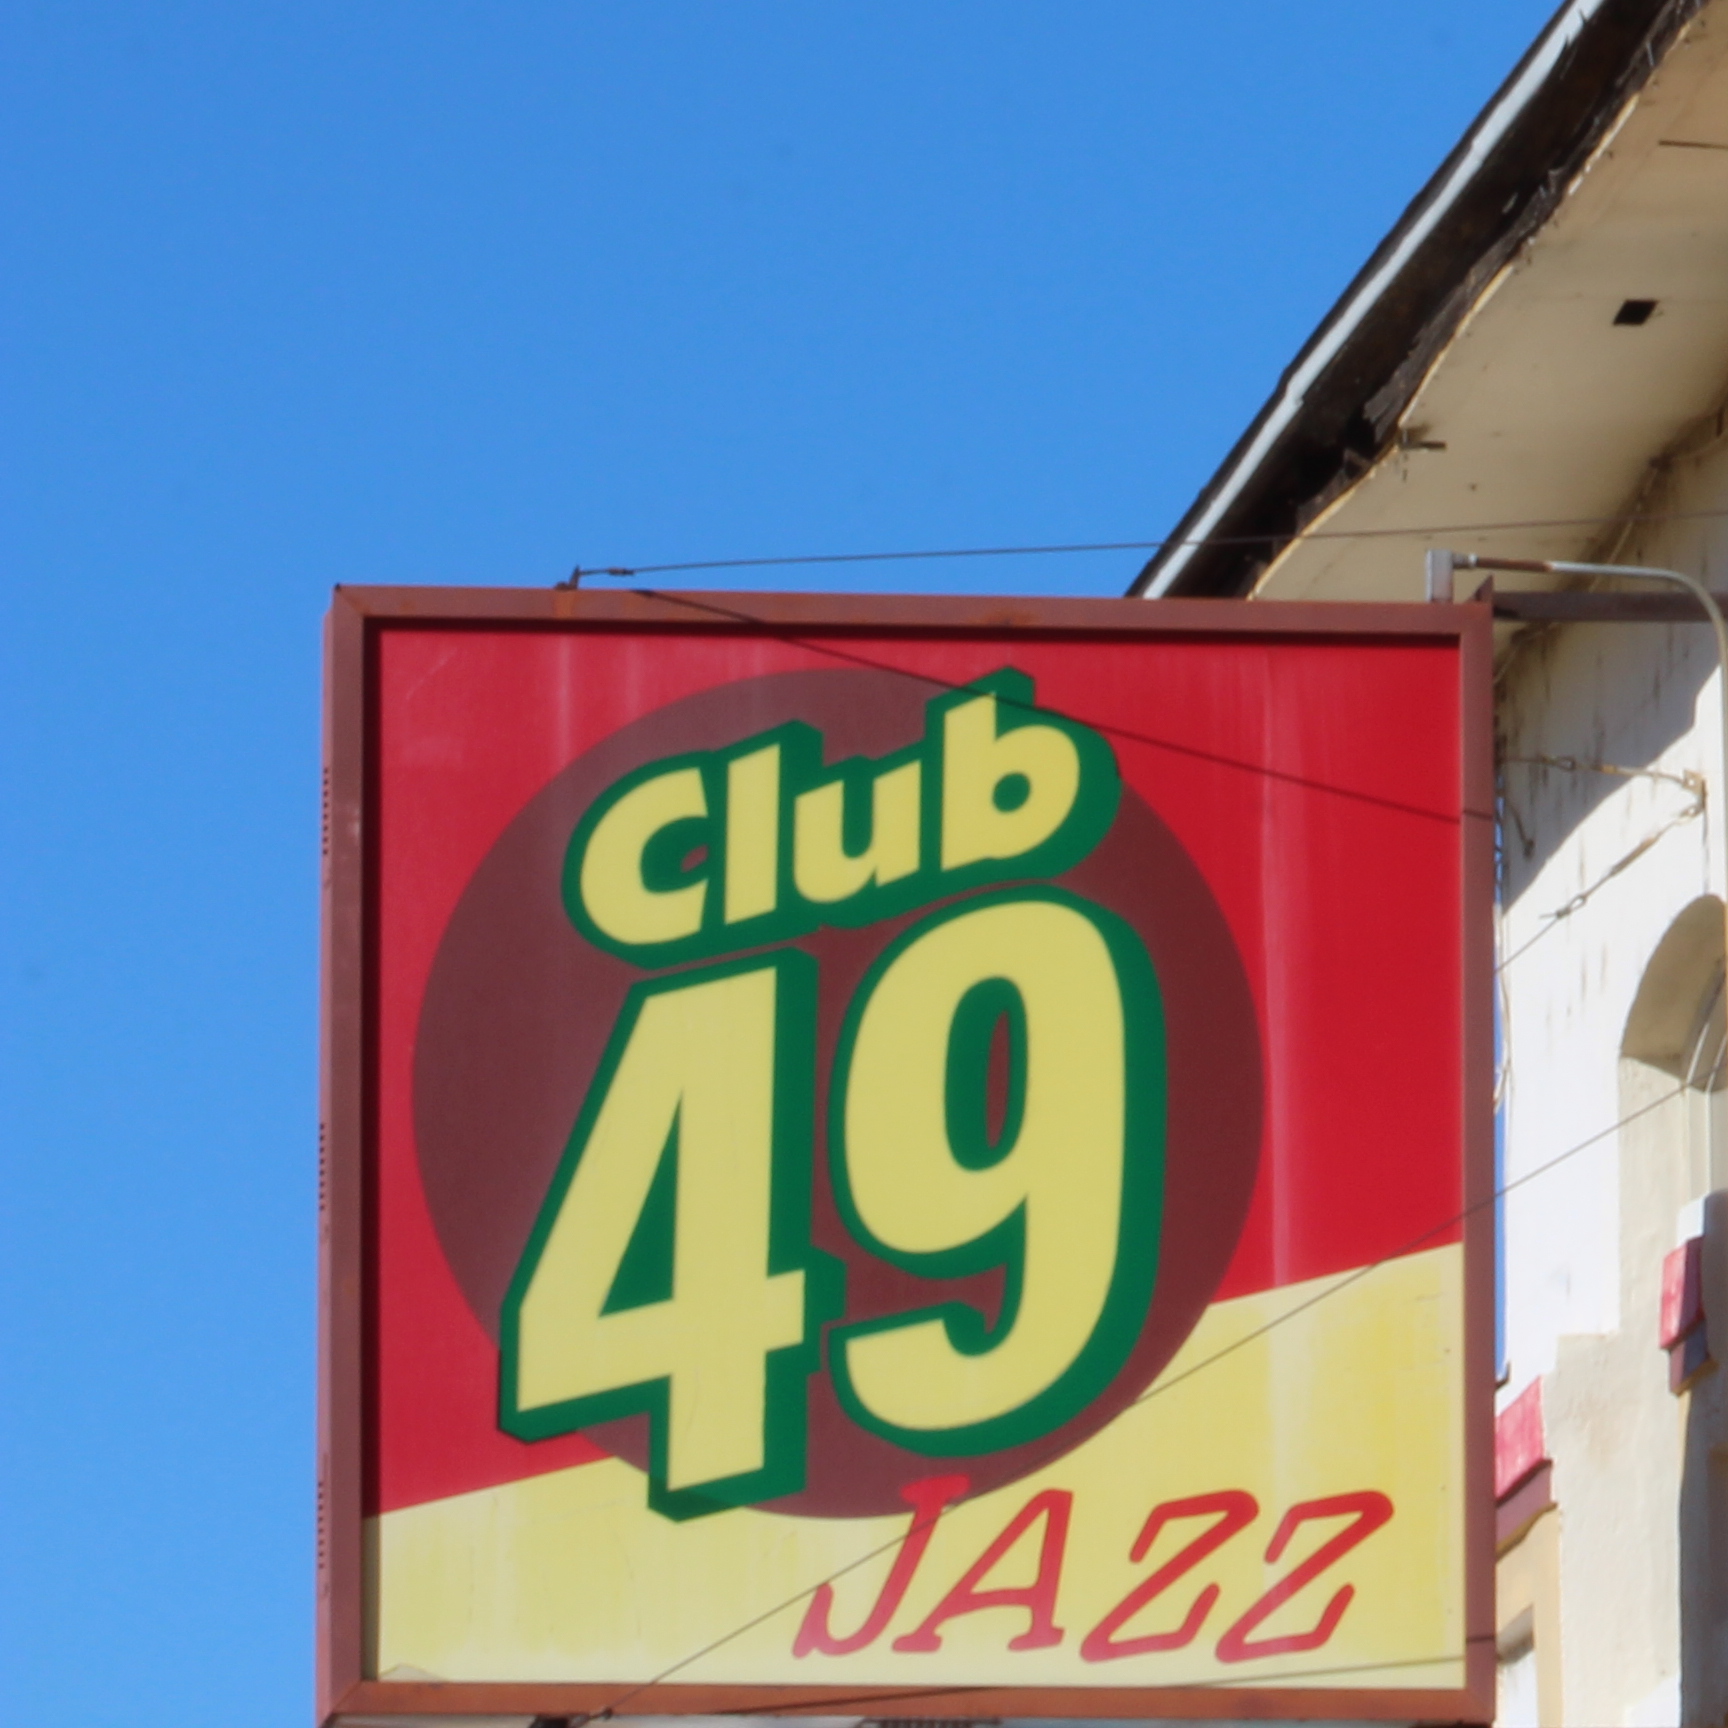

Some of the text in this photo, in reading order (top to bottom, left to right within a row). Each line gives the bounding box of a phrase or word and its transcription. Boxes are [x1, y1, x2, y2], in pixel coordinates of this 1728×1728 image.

[578, 689, 1085, 947] Club
[514, 897, 1128, 1494] 49
[791, 1473, 1396, 1664] JAZZ
